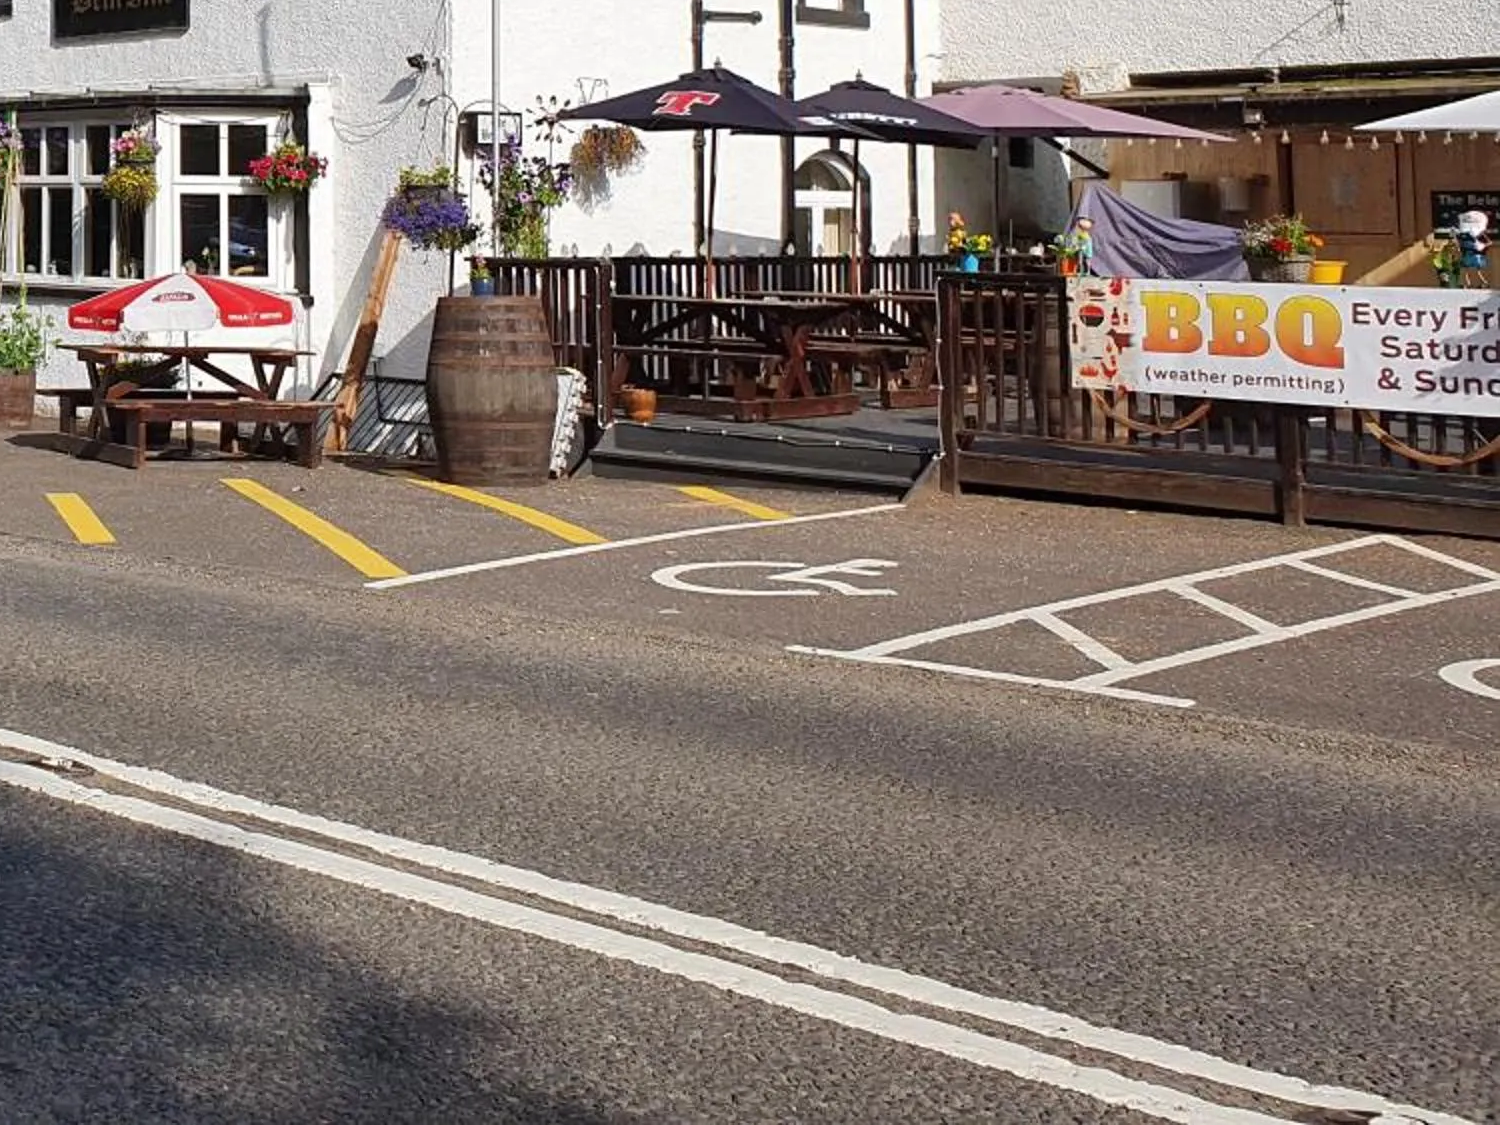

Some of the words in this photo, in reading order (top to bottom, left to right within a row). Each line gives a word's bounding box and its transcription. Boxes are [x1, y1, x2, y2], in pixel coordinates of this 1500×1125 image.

[1140, 291, 1345, 369] BBQ
[1351, 302, 1448, 333] Every
[1145, 365, 1227, 384] (weather
[1233, 374, 1346, 394] permitting)
[1378, 367, 1402, 390] &
